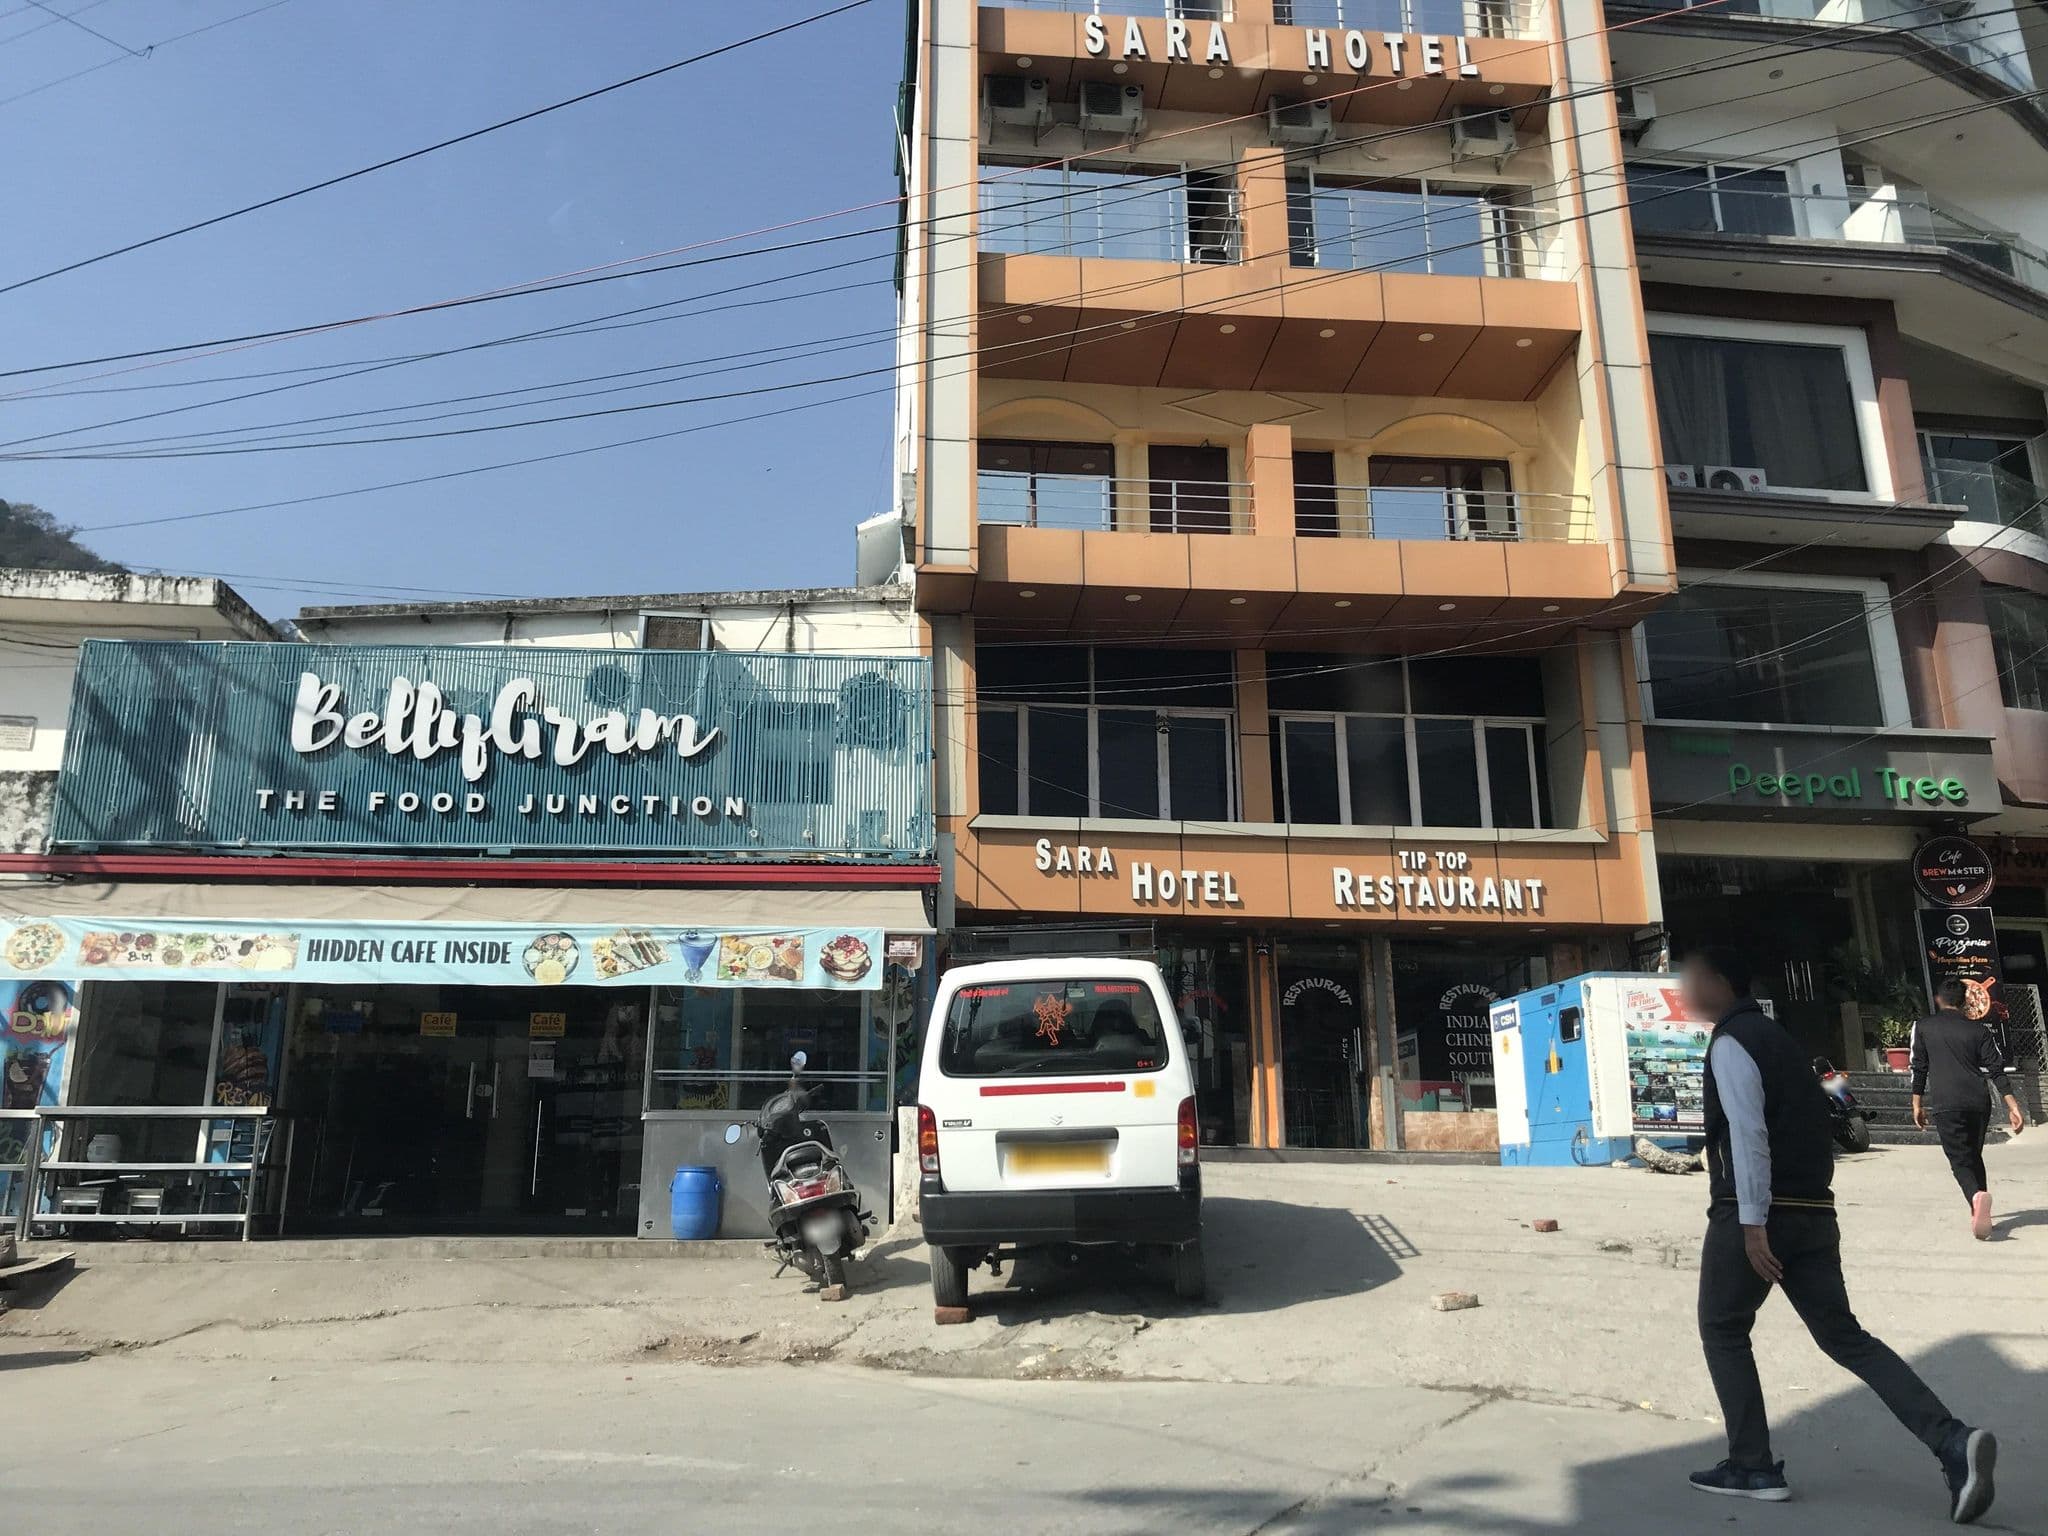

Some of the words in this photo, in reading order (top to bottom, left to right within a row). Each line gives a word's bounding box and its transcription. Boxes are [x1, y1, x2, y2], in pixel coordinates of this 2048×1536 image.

[1085, 14, 1230, 62] SARA
[1306, 27, 1479, 76] HOTEL
[291, 671, 720, 782] BellyGram
[1727, 763, 1861, 805] Peepal
[1875, 767, 1969, 802] Tree
[255, 788, 338, 812] THE
[368, 790, 486, 814] FOOD
[518, 793, 747, 817] JUNCTION
[1399, 850, 1428, 870] TIP
[1436, 851, 1468, 870] TOP
[1131, 861, 1240, 902] HOTEL
[1332, 867, 1543, 910] RESTAURANT
[306, 938, 387, 963] HIDDEN
[391, 939, 438, 964] CAFE
[443, 940, 512, 965] INSIDE
[1283, 977, 1353, 1006] RESTAURANT
[1439, 983, 1502, 1010] RESTAURA
[1446, 1015, 1490, 1029] INDIA
[1445, 1033, 1492, 1047] CHINE
